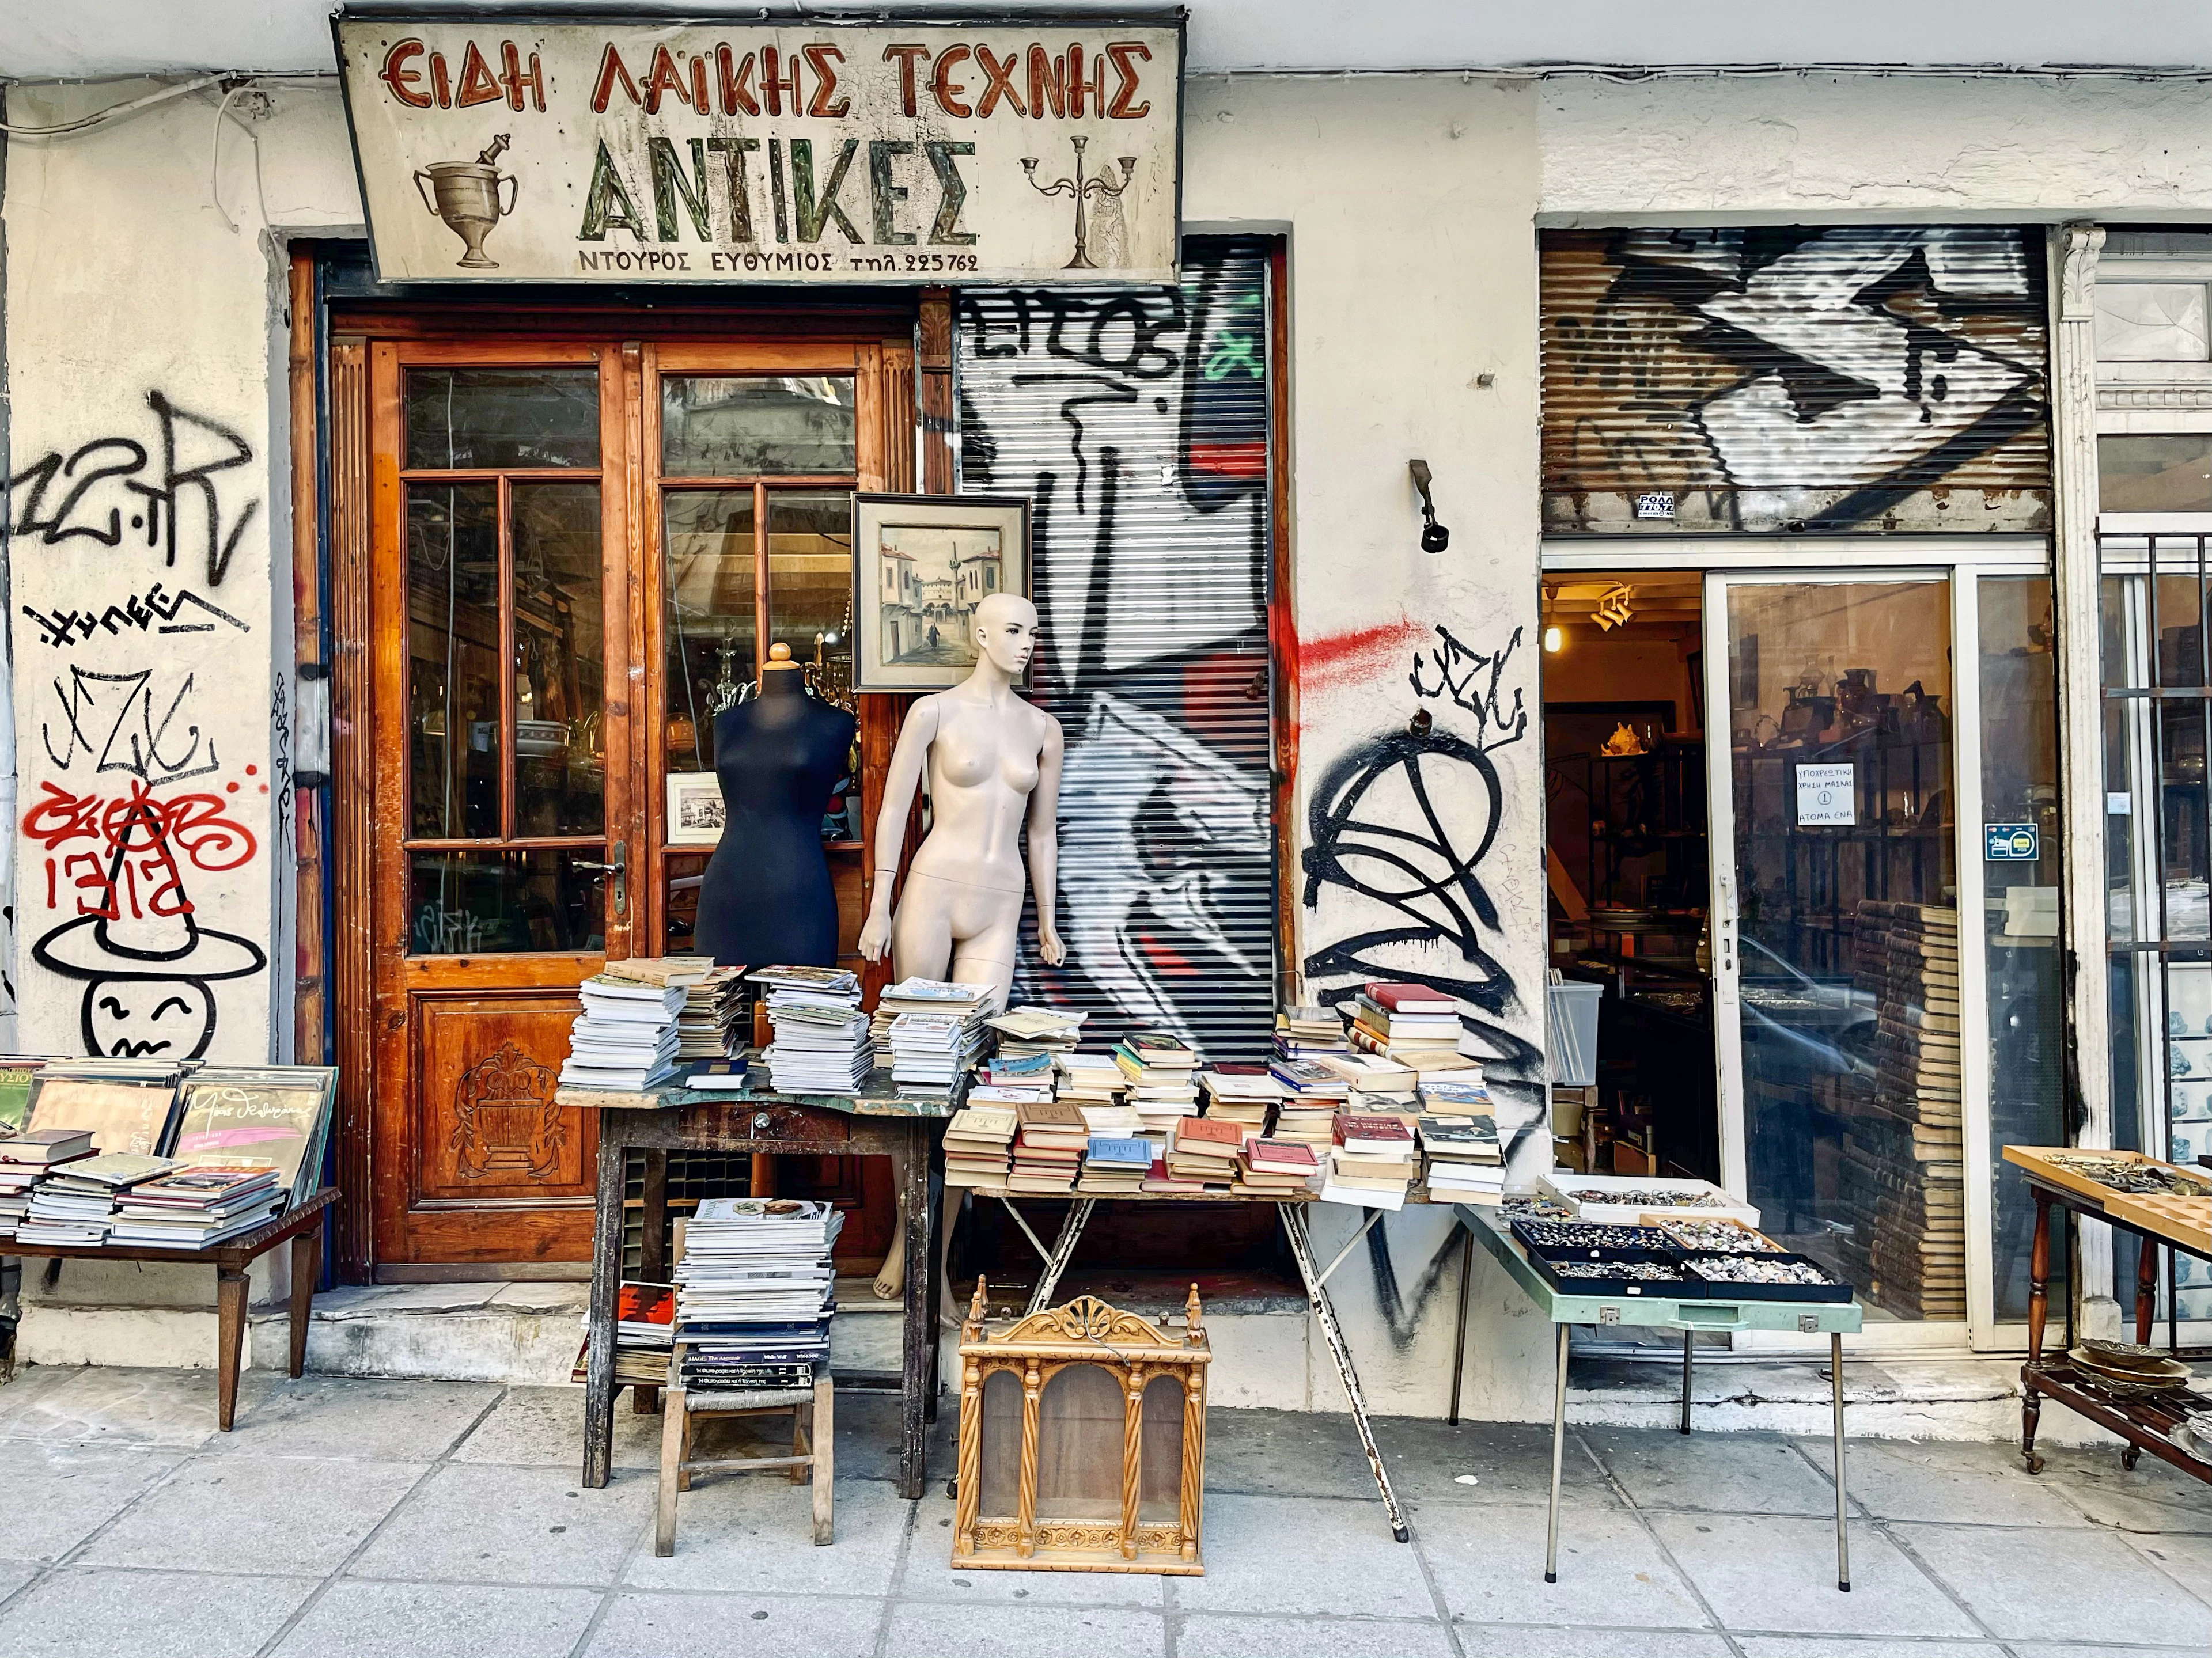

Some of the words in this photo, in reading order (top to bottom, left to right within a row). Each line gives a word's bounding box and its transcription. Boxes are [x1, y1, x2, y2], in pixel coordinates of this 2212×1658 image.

[378, 37, 547, 112] ΕΙΔΗ
[590, 40, 847, 119] ΛΑΪΚΗΣ
[881, 41, 1153, 120] ΤΕΧΝΗΣ
[576, 136, 978, 246] ΑΝΤΙΚΕΣ
[579, 250, 691, 271] ΝΤΟΥΡΟΣ
[711, 252, 833, 272] ΕΥΘΥΜΙΟΣ
[1798, 769, 1852, 779] ΥΠΟΧΡΕΩΤΙΚΗ
[1800, 813, 1830, 823] ΑΤΟΜΑ
[1834, 810, 1853, 818] ΕΝΑ
